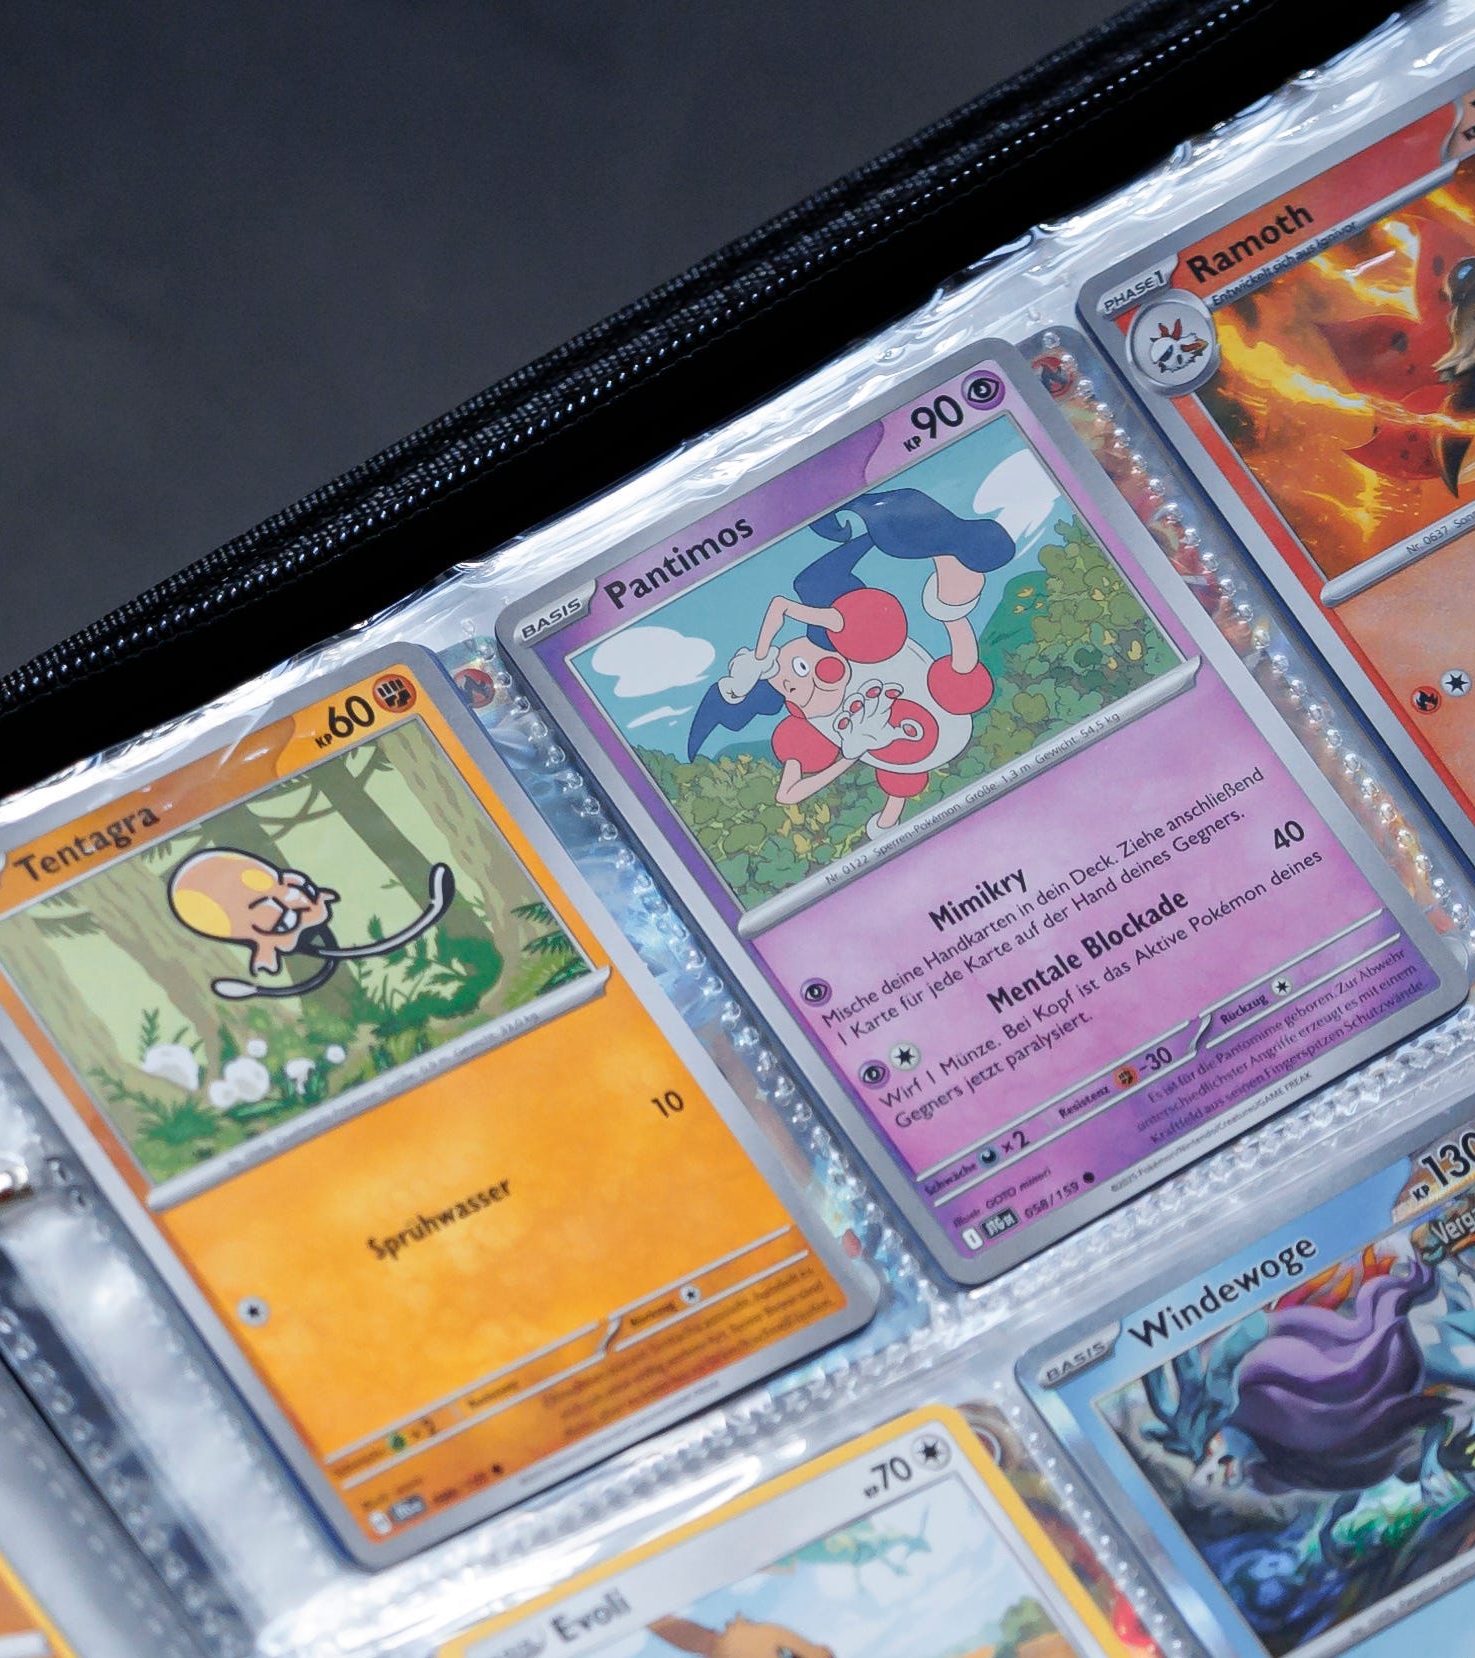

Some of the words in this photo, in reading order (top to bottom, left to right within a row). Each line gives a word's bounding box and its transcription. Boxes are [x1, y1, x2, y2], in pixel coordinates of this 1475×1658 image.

[1186, 205, 1313, 282] Ramoth
[1211, 267, 1276, 309] Entwickelt
[1271, 255, 1296, 278] sich
[1289, 243, 1320, 267] aus
[909, 393, 964, 439] 90
[901, 434, 922, 453] KP
[1421, 524, 1454, 550] 0637
[603, 518, 753, 609] Pantimos
[520, 597, 587, 643] BASIS
[313, 731, 334, 749] KP
[326, 694, 376, 739] 60
[1105, 712, 1126, 730] kg
[11, 807, 160, 881] Tentagra
[1272, 819, 1305, 850] 40
[820, 990, 880, 1029] Mische
[879, 964, 925, 996] deine
[921, 911, 1018, 970] Handkarten
[1014, 901, 1036, 917] in
[1035, 880, 1071, 906] dein
[1067, 853, 1119, 886] Deck.
[1114, 826, 1166, 859] Ziehe
[1165, 765, 1264, 832] anschließend
[927, 868, 1027, 932] Mimikry
[848, 1005, 900, 1039] Karte
[897, 989, 924, 1011] für
[925, 968, 964, 999] jede
[962, 940, 1014, 974] Karte
[1013, 919, 1040, 946] auf
[1041, 905, 1069, 929] der
[1069, 875, 1118, 912] Hand
[1119, 849, 1172, 885] deines
[1171, 809, 1245, 853] Gegners.
[985, 953, 1082, 1013] Mentale
[1080, 892, 1188, 959] Blockade
[877, 1075, 923, 1109] Wirf
[937, 1038, 1002, 1076] Münze.
[1000, 1014, 1032, 1040] Bei
[1031, 987, 1075, 1023] Kopf
[1074, 978, 1101, 998] ist
[1101, 960, 1132, 983] das
[1133, 928, 1188, 966] Aktive
[1187, 882, 1267, 933] Pokémon
[1269, 850, 1323, 886] deines
[1218, 993, 1270, 1025] Rückzug
[893, 1084, 964, 1129] Gegners
[964, 1060, 1005, 1095] jetzt
[1004, 1011, 1093, 1071] paralysiert.
[649, 1089, 685, 1118] 10
[1411, 1182, 1431, 1202] KP
[366, 1179, 510, 1260] Sprühwasser
[1128, 1239, 1315, 1347] Windewoge
[1044, 1343, 1113, 1388] BASIS
[869, 1455, 913, 1491] 70
[549, 1592, 630, 1643] Evoli
